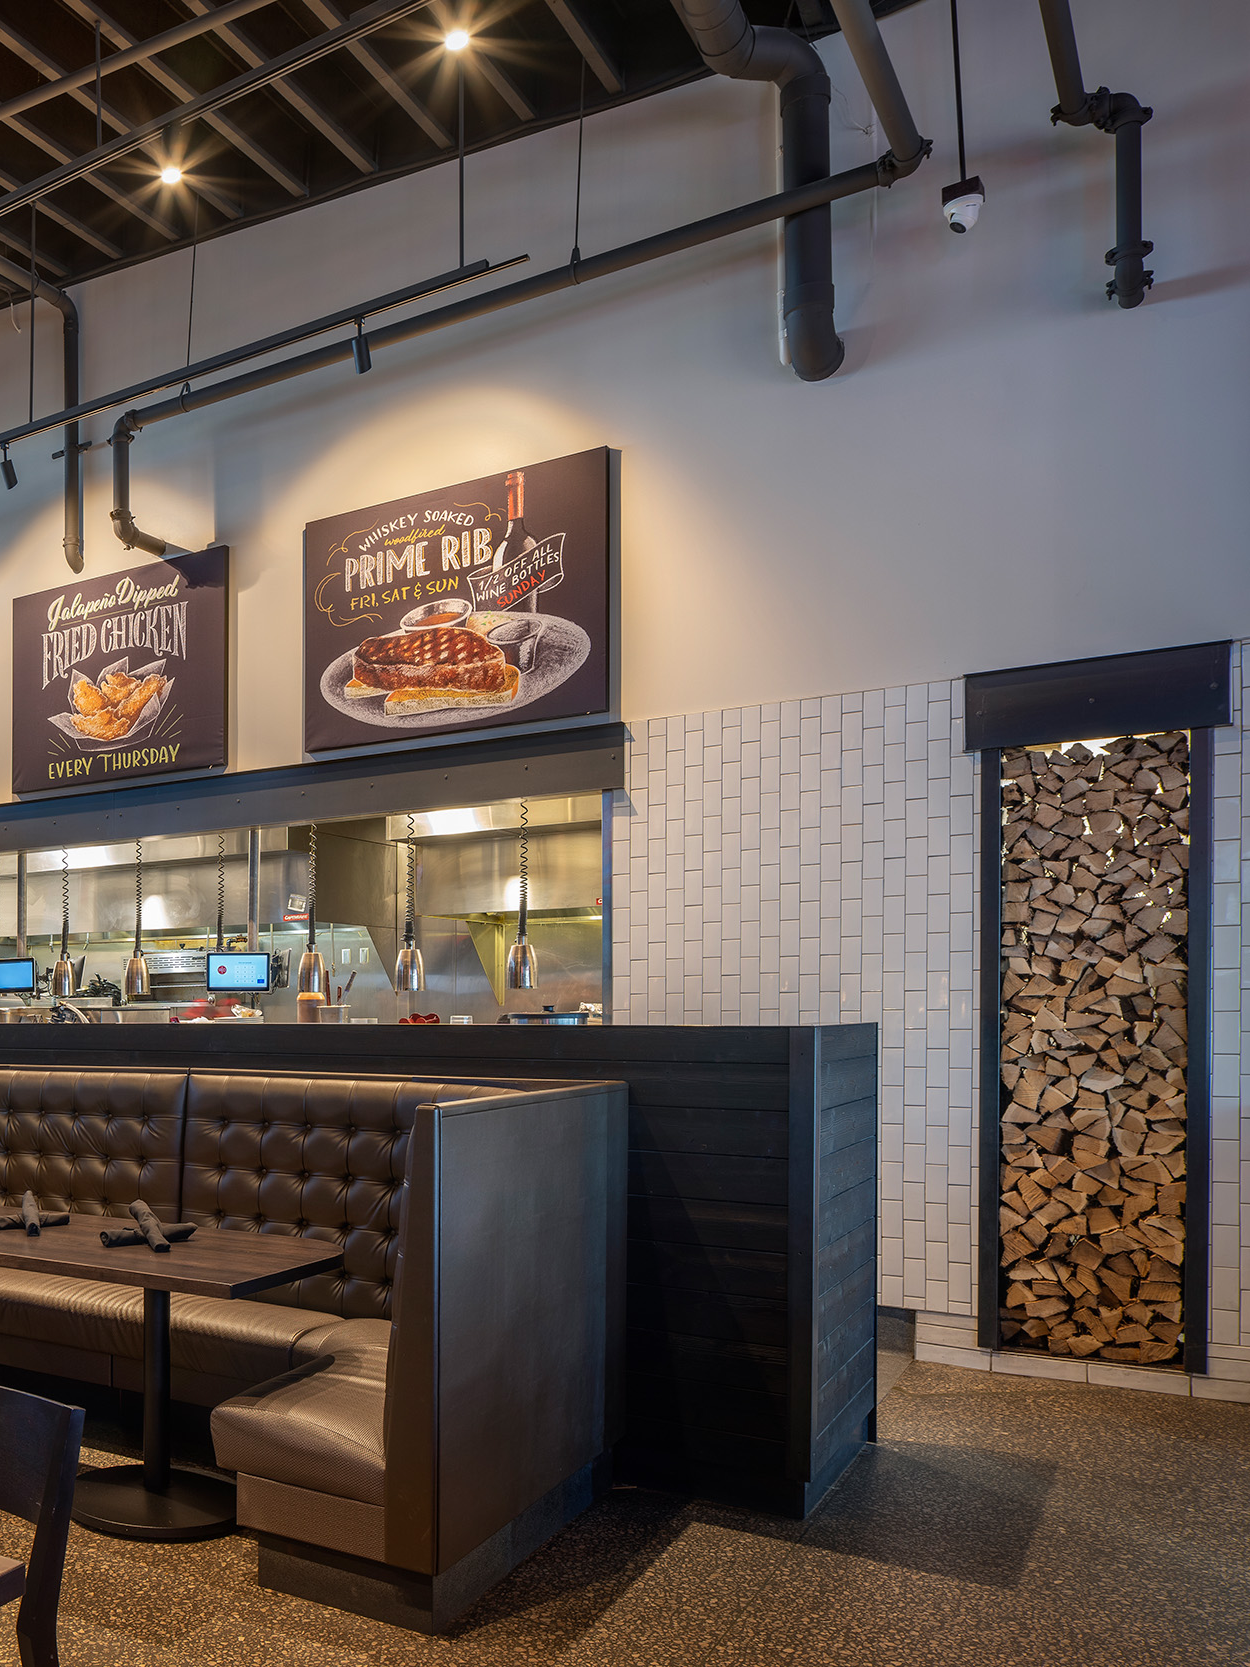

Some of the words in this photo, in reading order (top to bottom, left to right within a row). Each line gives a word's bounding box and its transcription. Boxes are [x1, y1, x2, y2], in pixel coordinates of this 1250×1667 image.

[358, 513, 418, 552] WHISKEY
[423, 509, 474, 526] SOAKED
[384, 524, 446, 546] woodfired
[344, 541, 430, 593] PRIME
[441, 527, 494, 571] RIB
[476, 582, 507, 602] WINE
[511, 551, 560, 586] BOTTLES
[478, 574, 500, 591] 1/2
[504, 557, 528, 578] OFF
[531, 543, 553, 562] ALL
[47, 592, 117, 632] Jalapeño
[114, 574, 180, 608] Dipped
[350, 592, 379, 611] FRI,
[381, 586, 411, 604] SAT
[413, 582, 423, 600] &
[425, 575, 459, 595] SUN
[496, 569, 546, 608] SUNDAY
[41, 622, 98, 691] FRIED
[100, 600, 189, 661] CHICKEN
[48, 756, 93, 780] EVERY
[96, 743, 181, 773] THURSDAY
